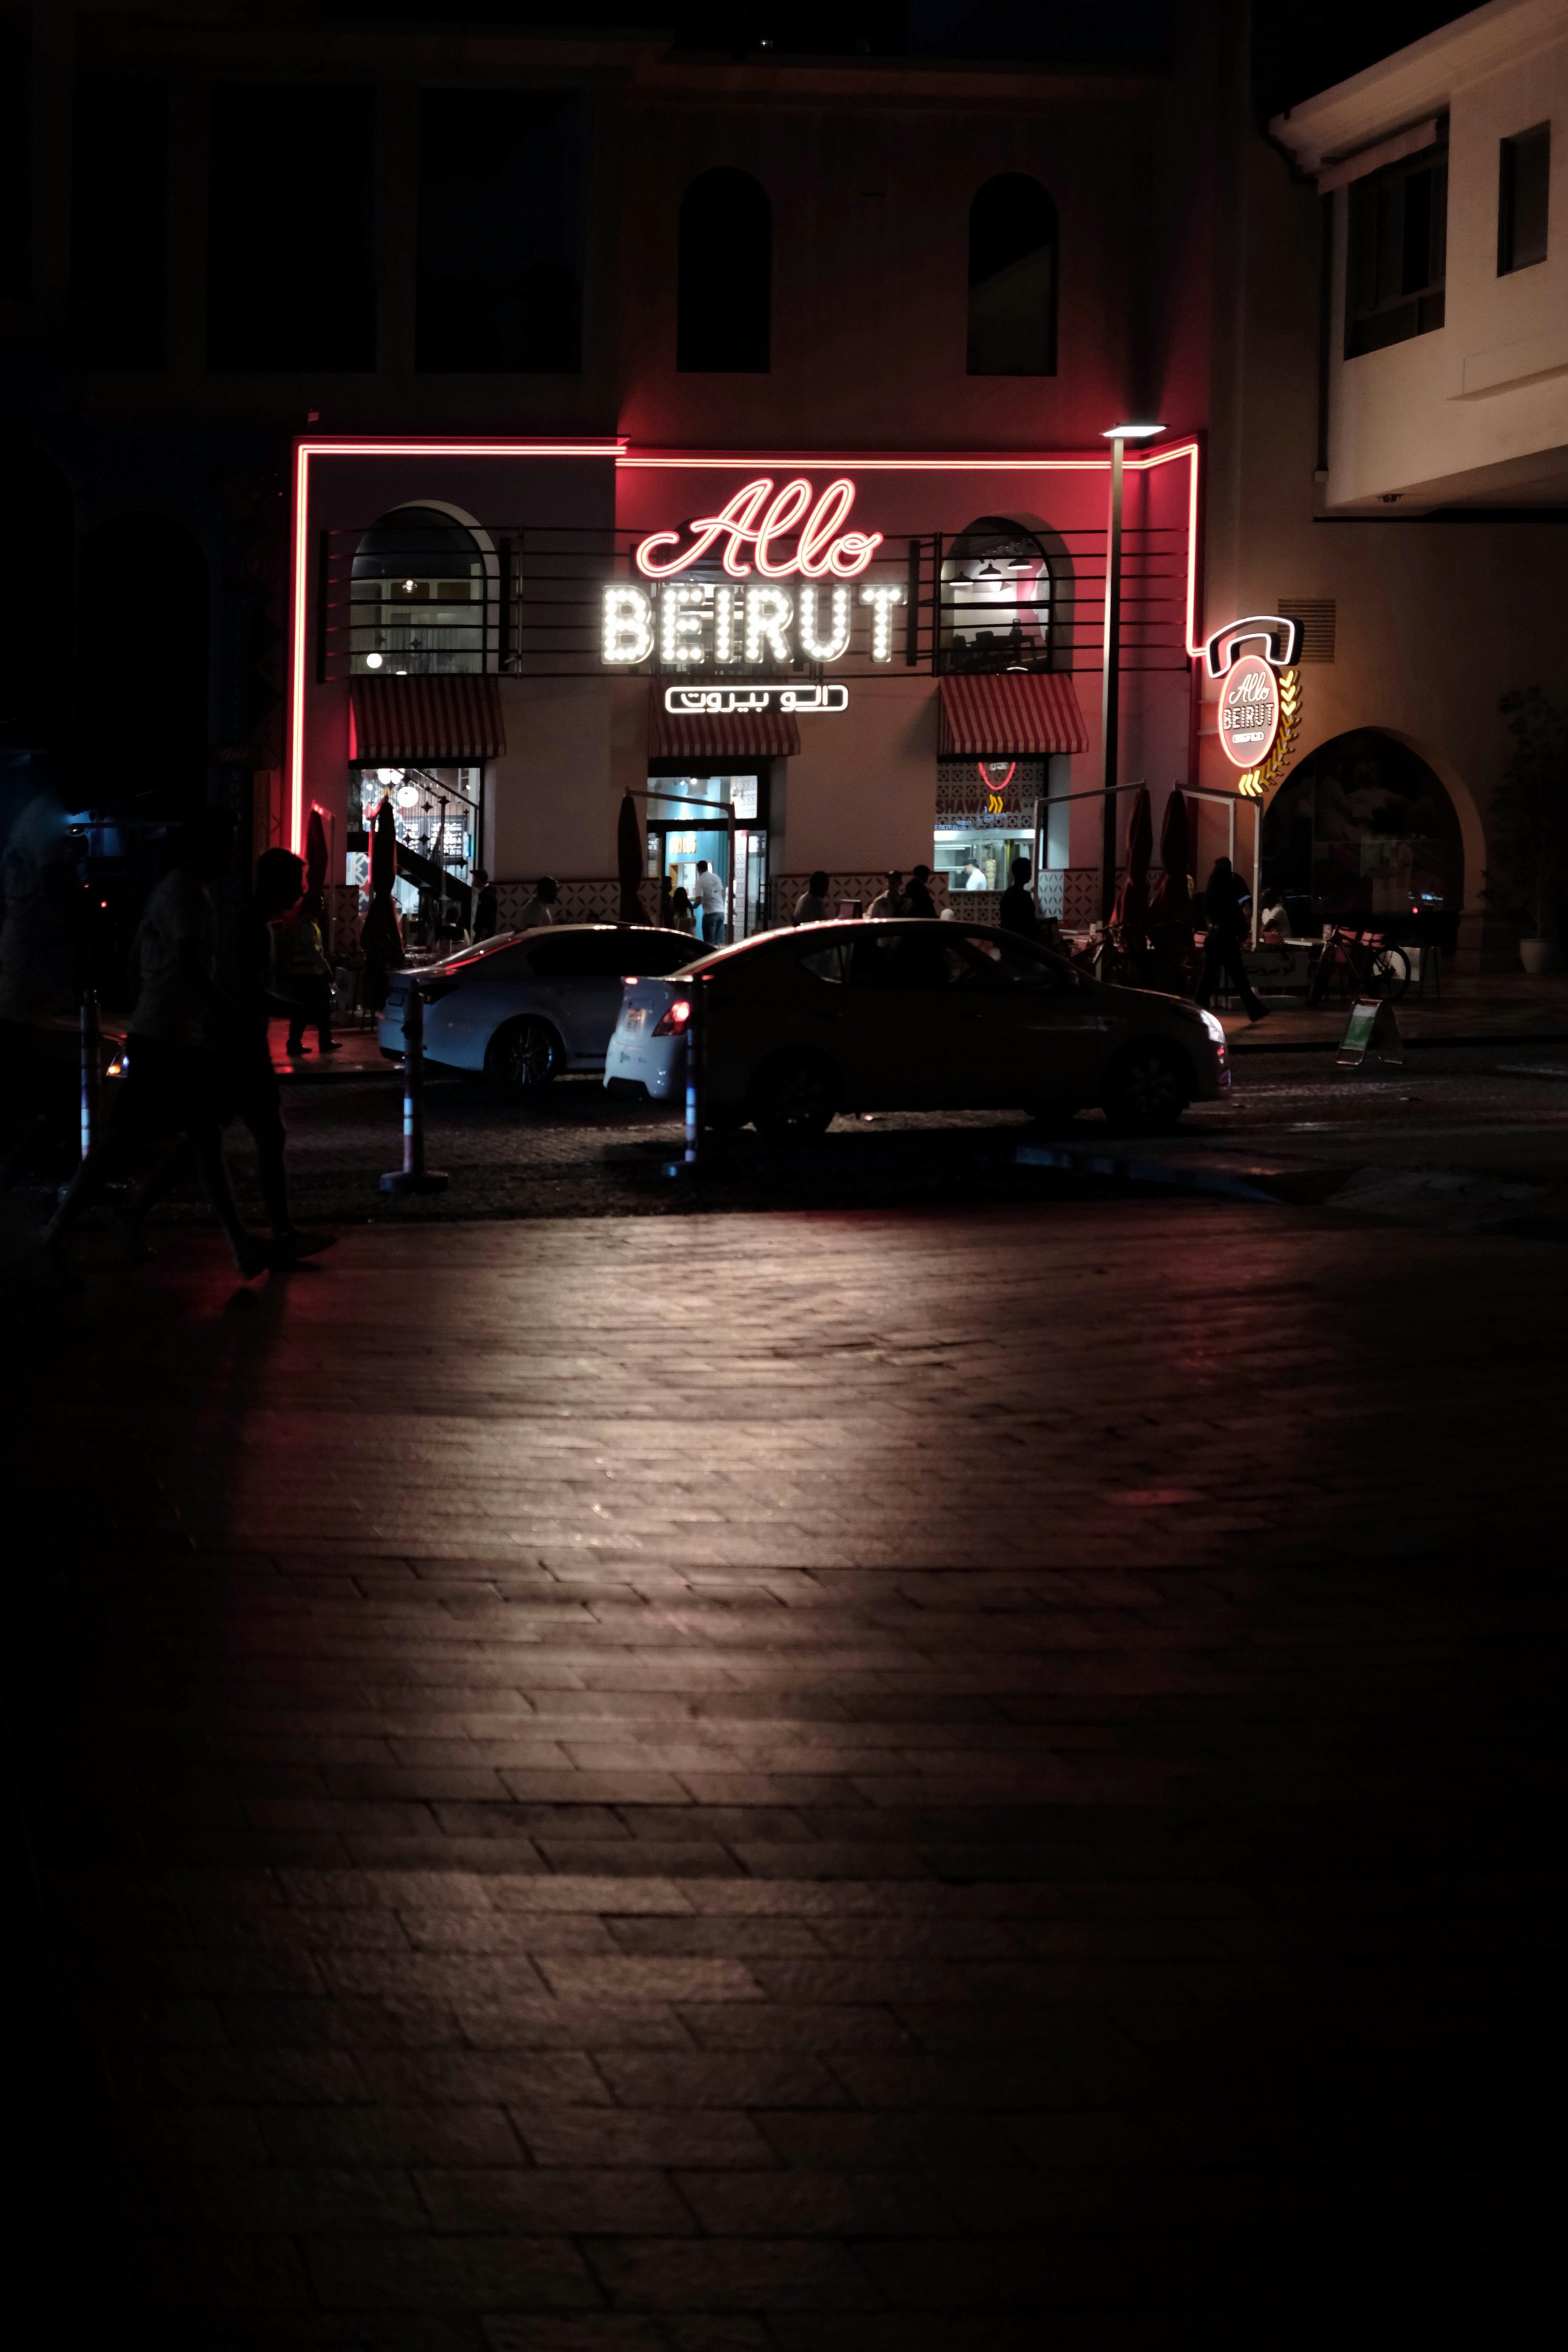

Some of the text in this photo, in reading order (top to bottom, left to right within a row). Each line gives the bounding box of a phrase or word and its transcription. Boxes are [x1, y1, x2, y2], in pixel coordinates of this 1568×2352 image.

[636, 478, 883, 577] Allo
[601, 585, 907, 664] BEIRUT
[680, 692, 769, 712] بيروت
[1229, 671, 1271, 704] Allo
[1223, 703, 1274, 729] BEIRUT
[935, 799, 1022, 814] SHAWAMA
